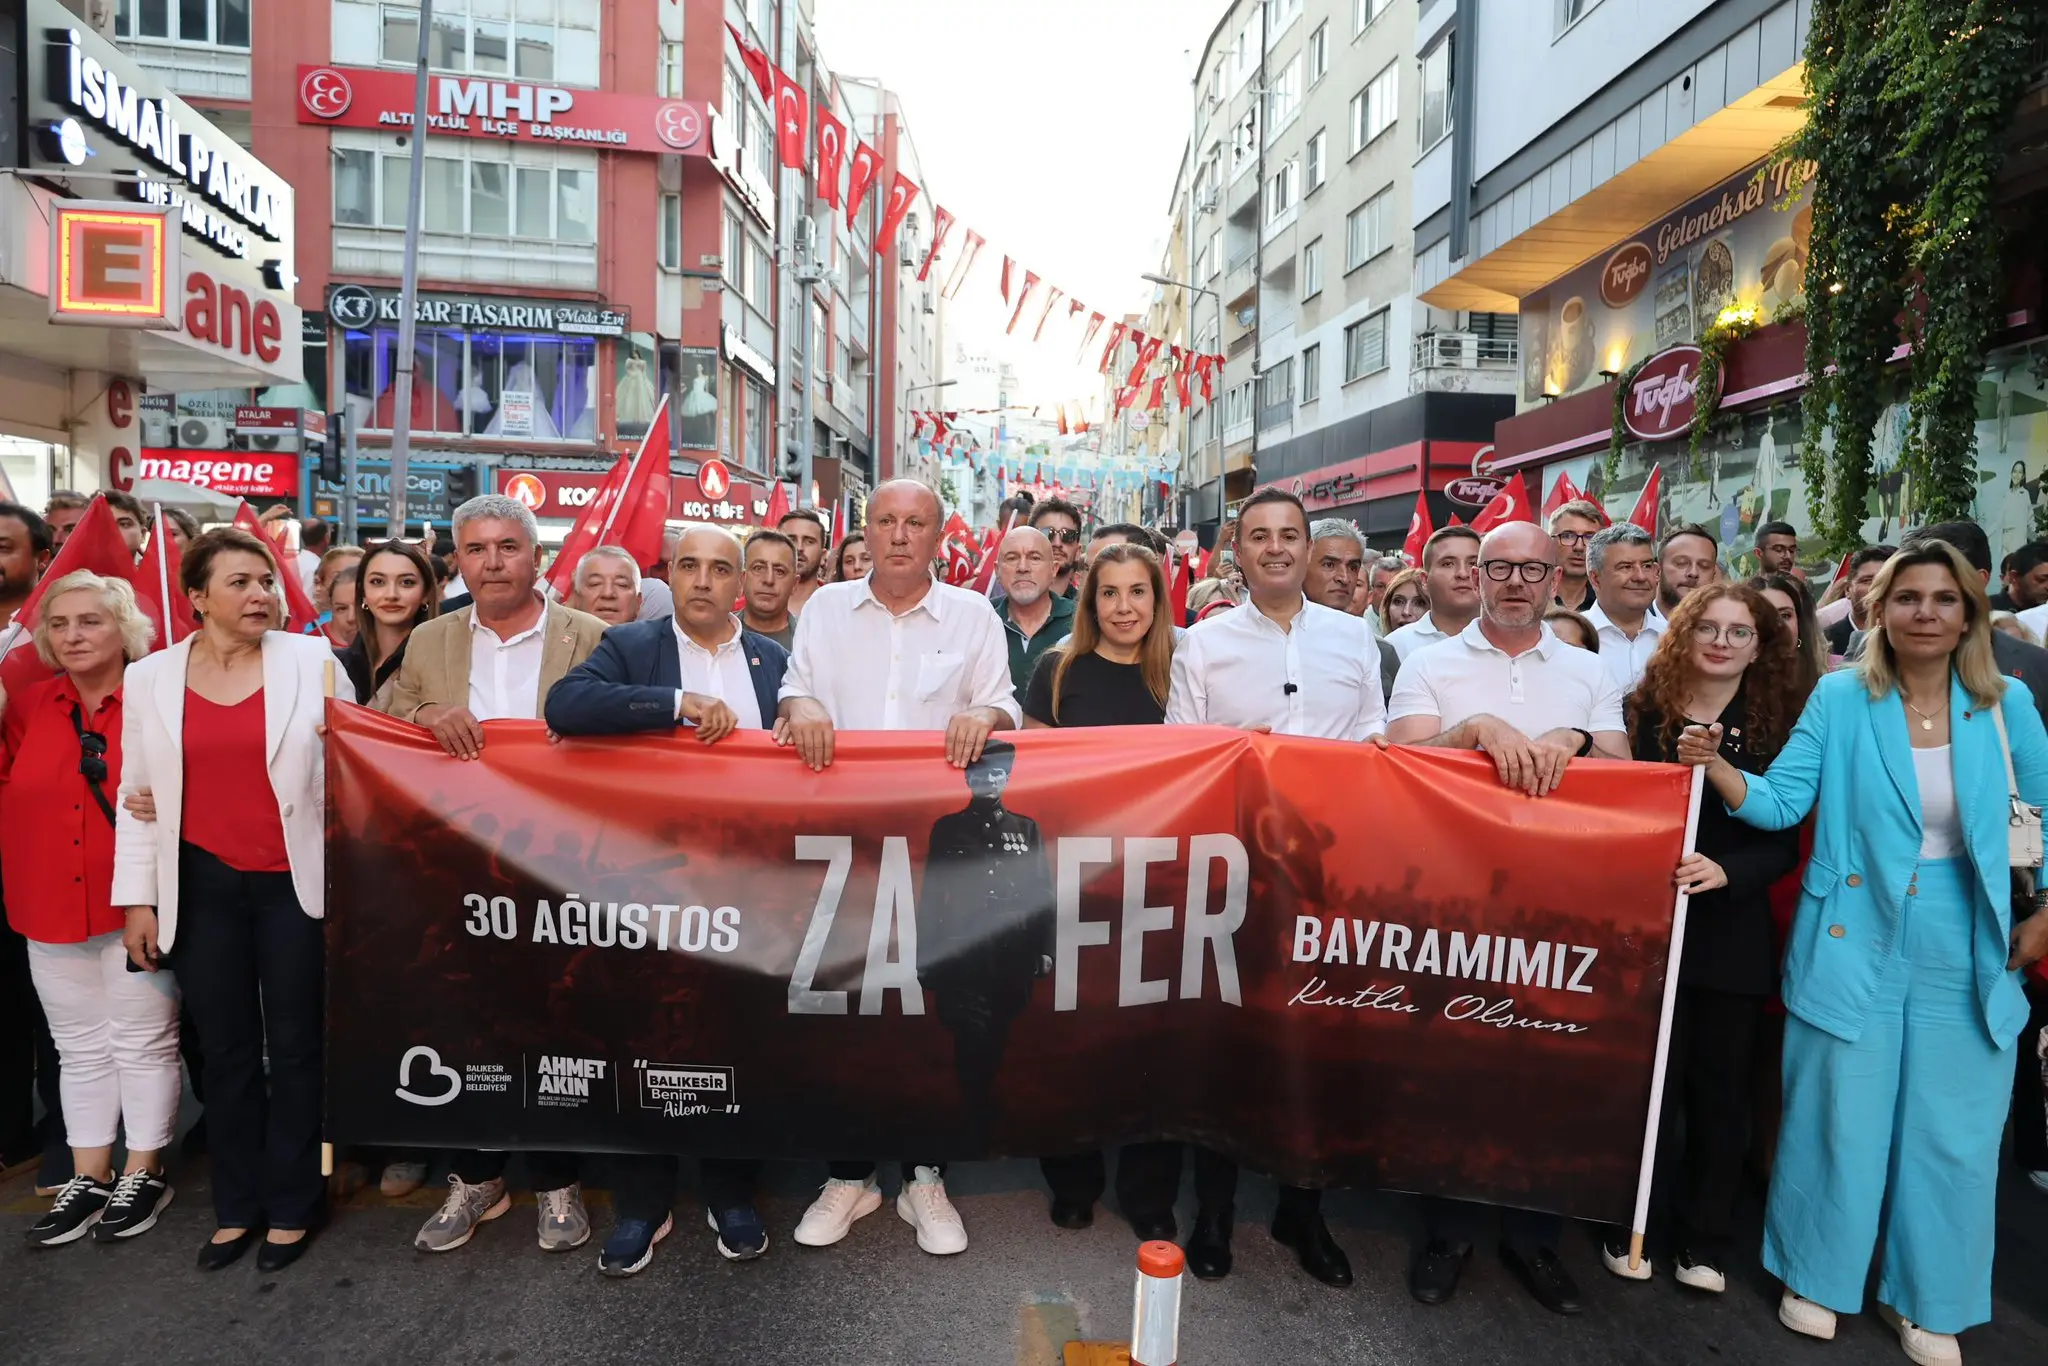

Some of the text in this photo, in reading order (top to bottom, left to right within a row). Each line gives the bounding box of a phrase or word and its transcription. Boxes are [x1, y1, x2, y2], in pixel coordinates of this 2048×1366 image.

[70, 28, 187, 176] İSMAİL
[437, 78, 574, 124] MHP
[379, 110, 628, 145] ALTIYLÜL İLÇE BAŞKANLIĞI
[1656, 175, 1767, 265] Geleneksel
[185, 271, 282, 363] ane
[456, 303, 553, 329] TASARIM
[556, 307, 598, 324] Moda
[600, 311, 625, 326] Evi
[238, 410, 272, 420] ATALAR
[139, 457, 274, 489] magene
[405, 475, 442, 493] Cep
[682, 501, 711, 520] KOÇ
[463, 891, 741, 953] 30 AĞUSTOS
[1292, 914, 1600, 994] BAYRAMIMIZ
[1287, 976, 1588, 1034] Kutlu Olsun
[466, 1063, 504, 1073] BALIKESİR
[466, 1072, 513, 1083] BÜYÜKŞEHİR
[537, 1055, 607, 1079] AHMET
[466, 1082, 507, 1092] BELEDİYESİ
[538, 1074, 589, 1097] AKIN
[649, 1073, 725, 1090] BALIKESİR
[651, 1088, 697, 1102] Benim
[663, 1100, 710, 1118] Ailem
